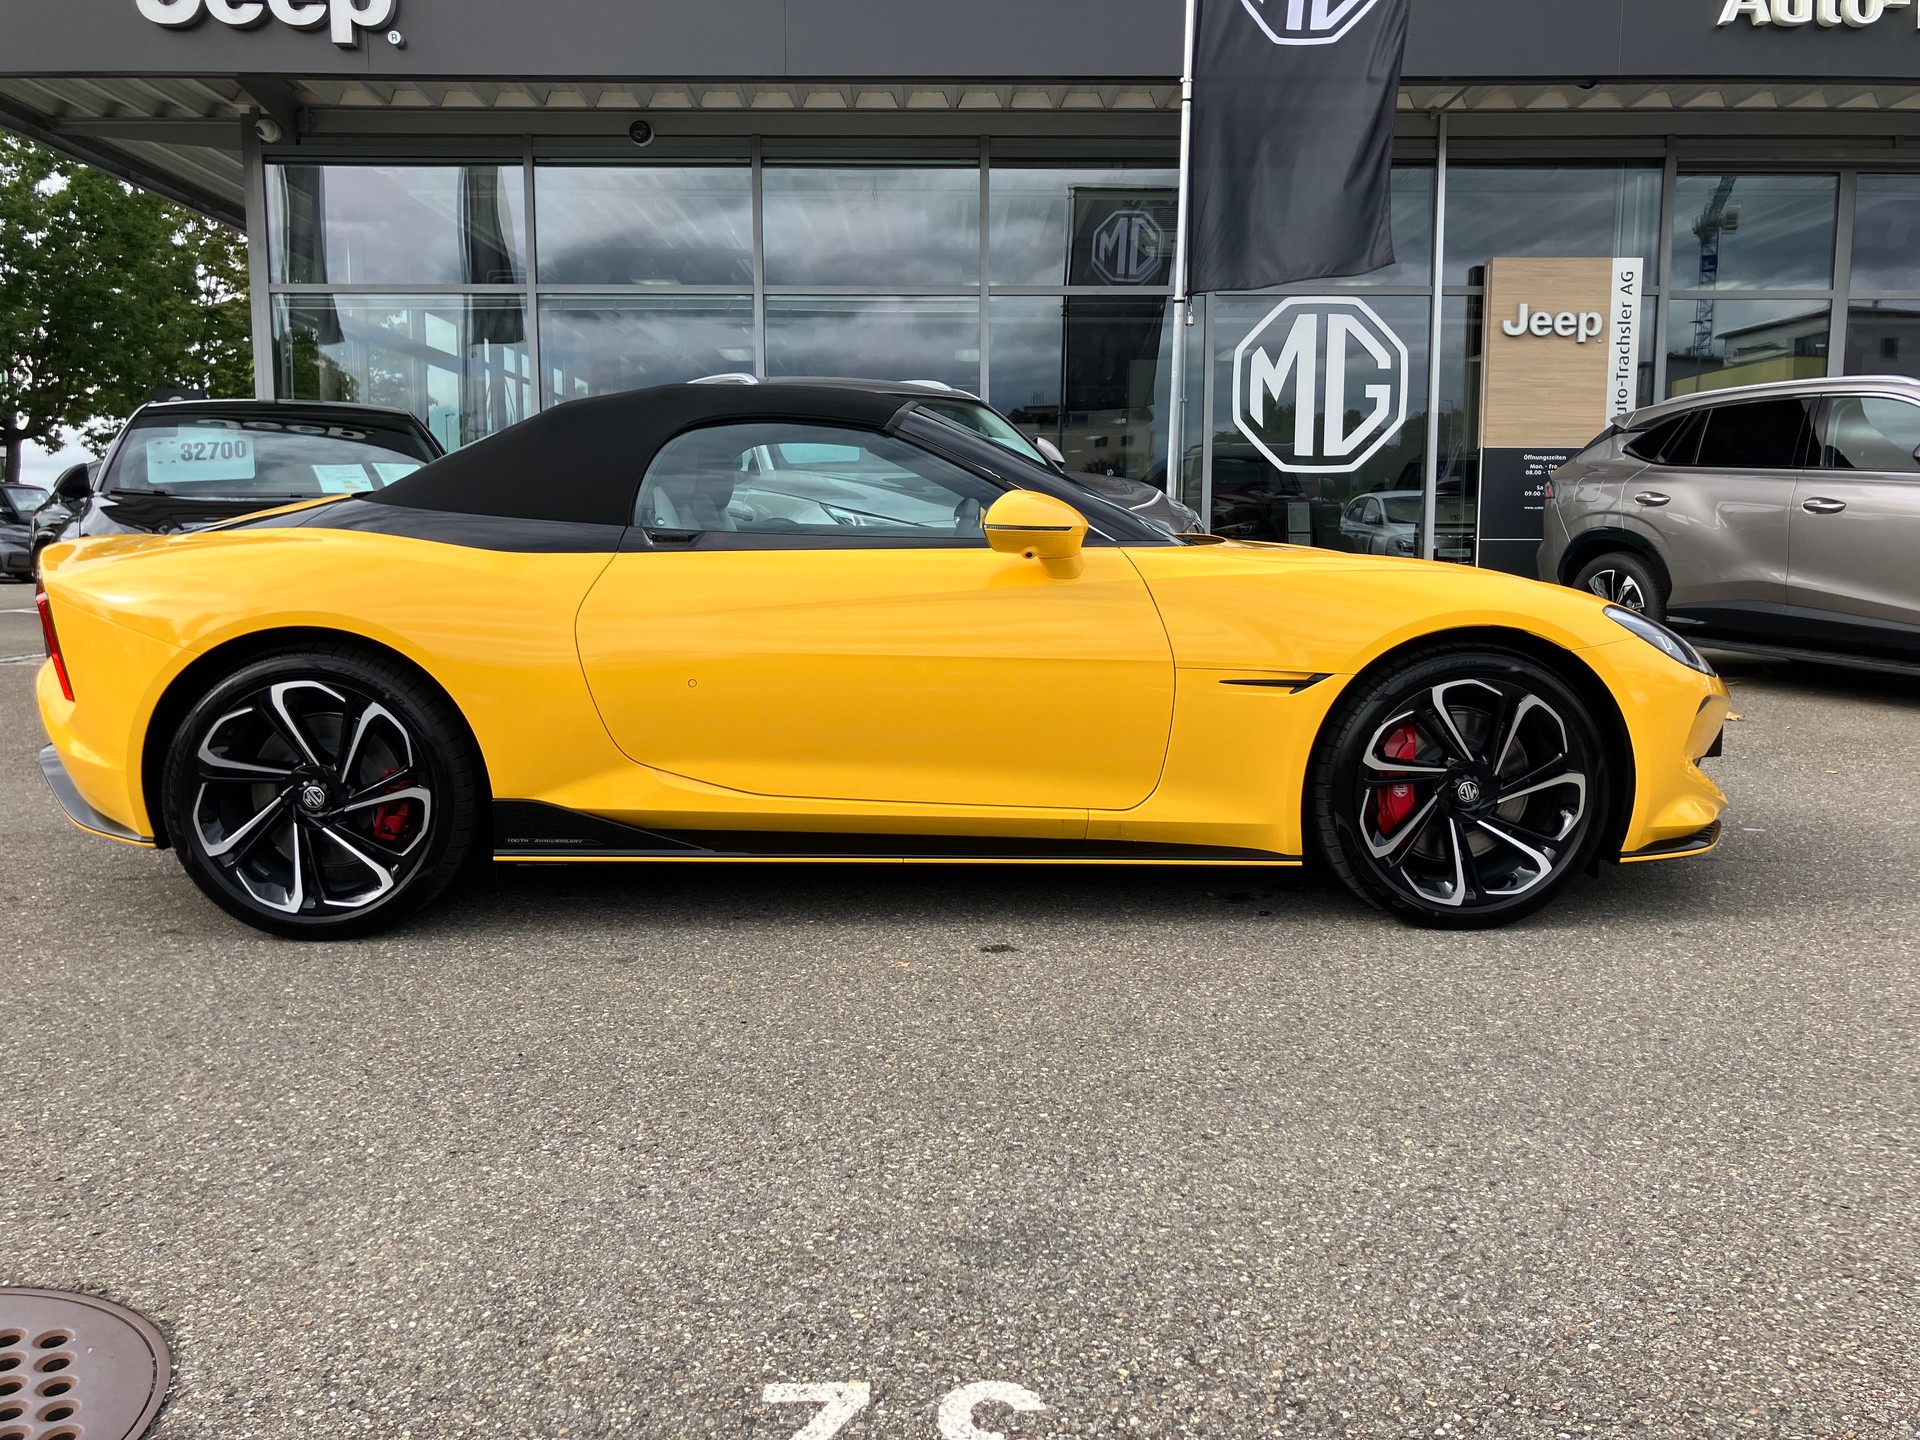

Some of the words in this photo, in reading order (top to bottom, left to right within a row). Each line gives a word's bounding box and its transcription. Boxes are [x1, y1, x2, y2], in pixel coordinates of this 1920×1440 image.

[1620, 271, 1634, 295] AG
[1502, 303, 1604, 343] Jeep
[1615, 302, 1632, 416] uto-Trachsler
[1249, 313, 1392, 457] MG
[180, 440, 247, 461] 32700
[304, 787, 324, 807] MG
